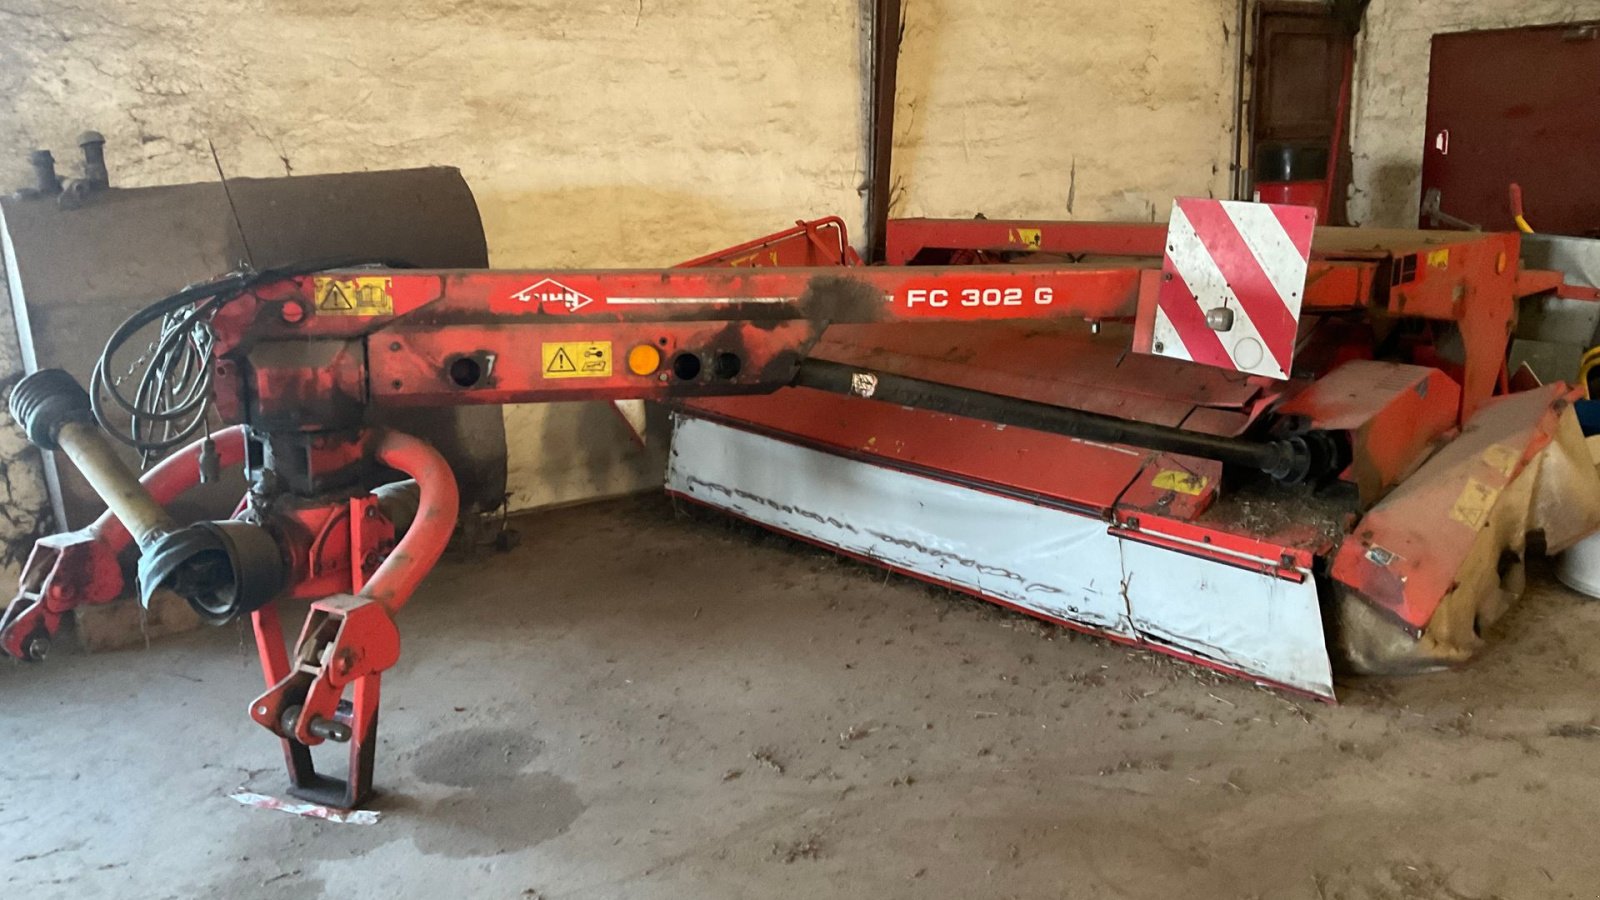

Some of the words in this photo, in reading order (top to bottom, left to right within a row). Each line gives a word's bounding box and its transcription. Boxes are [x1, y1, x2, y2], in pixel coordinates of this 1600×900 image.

[907, 289, 949, 307] FC
[961, 288, 1022, 306] 302
[1034, 287, 1053, 305] G
